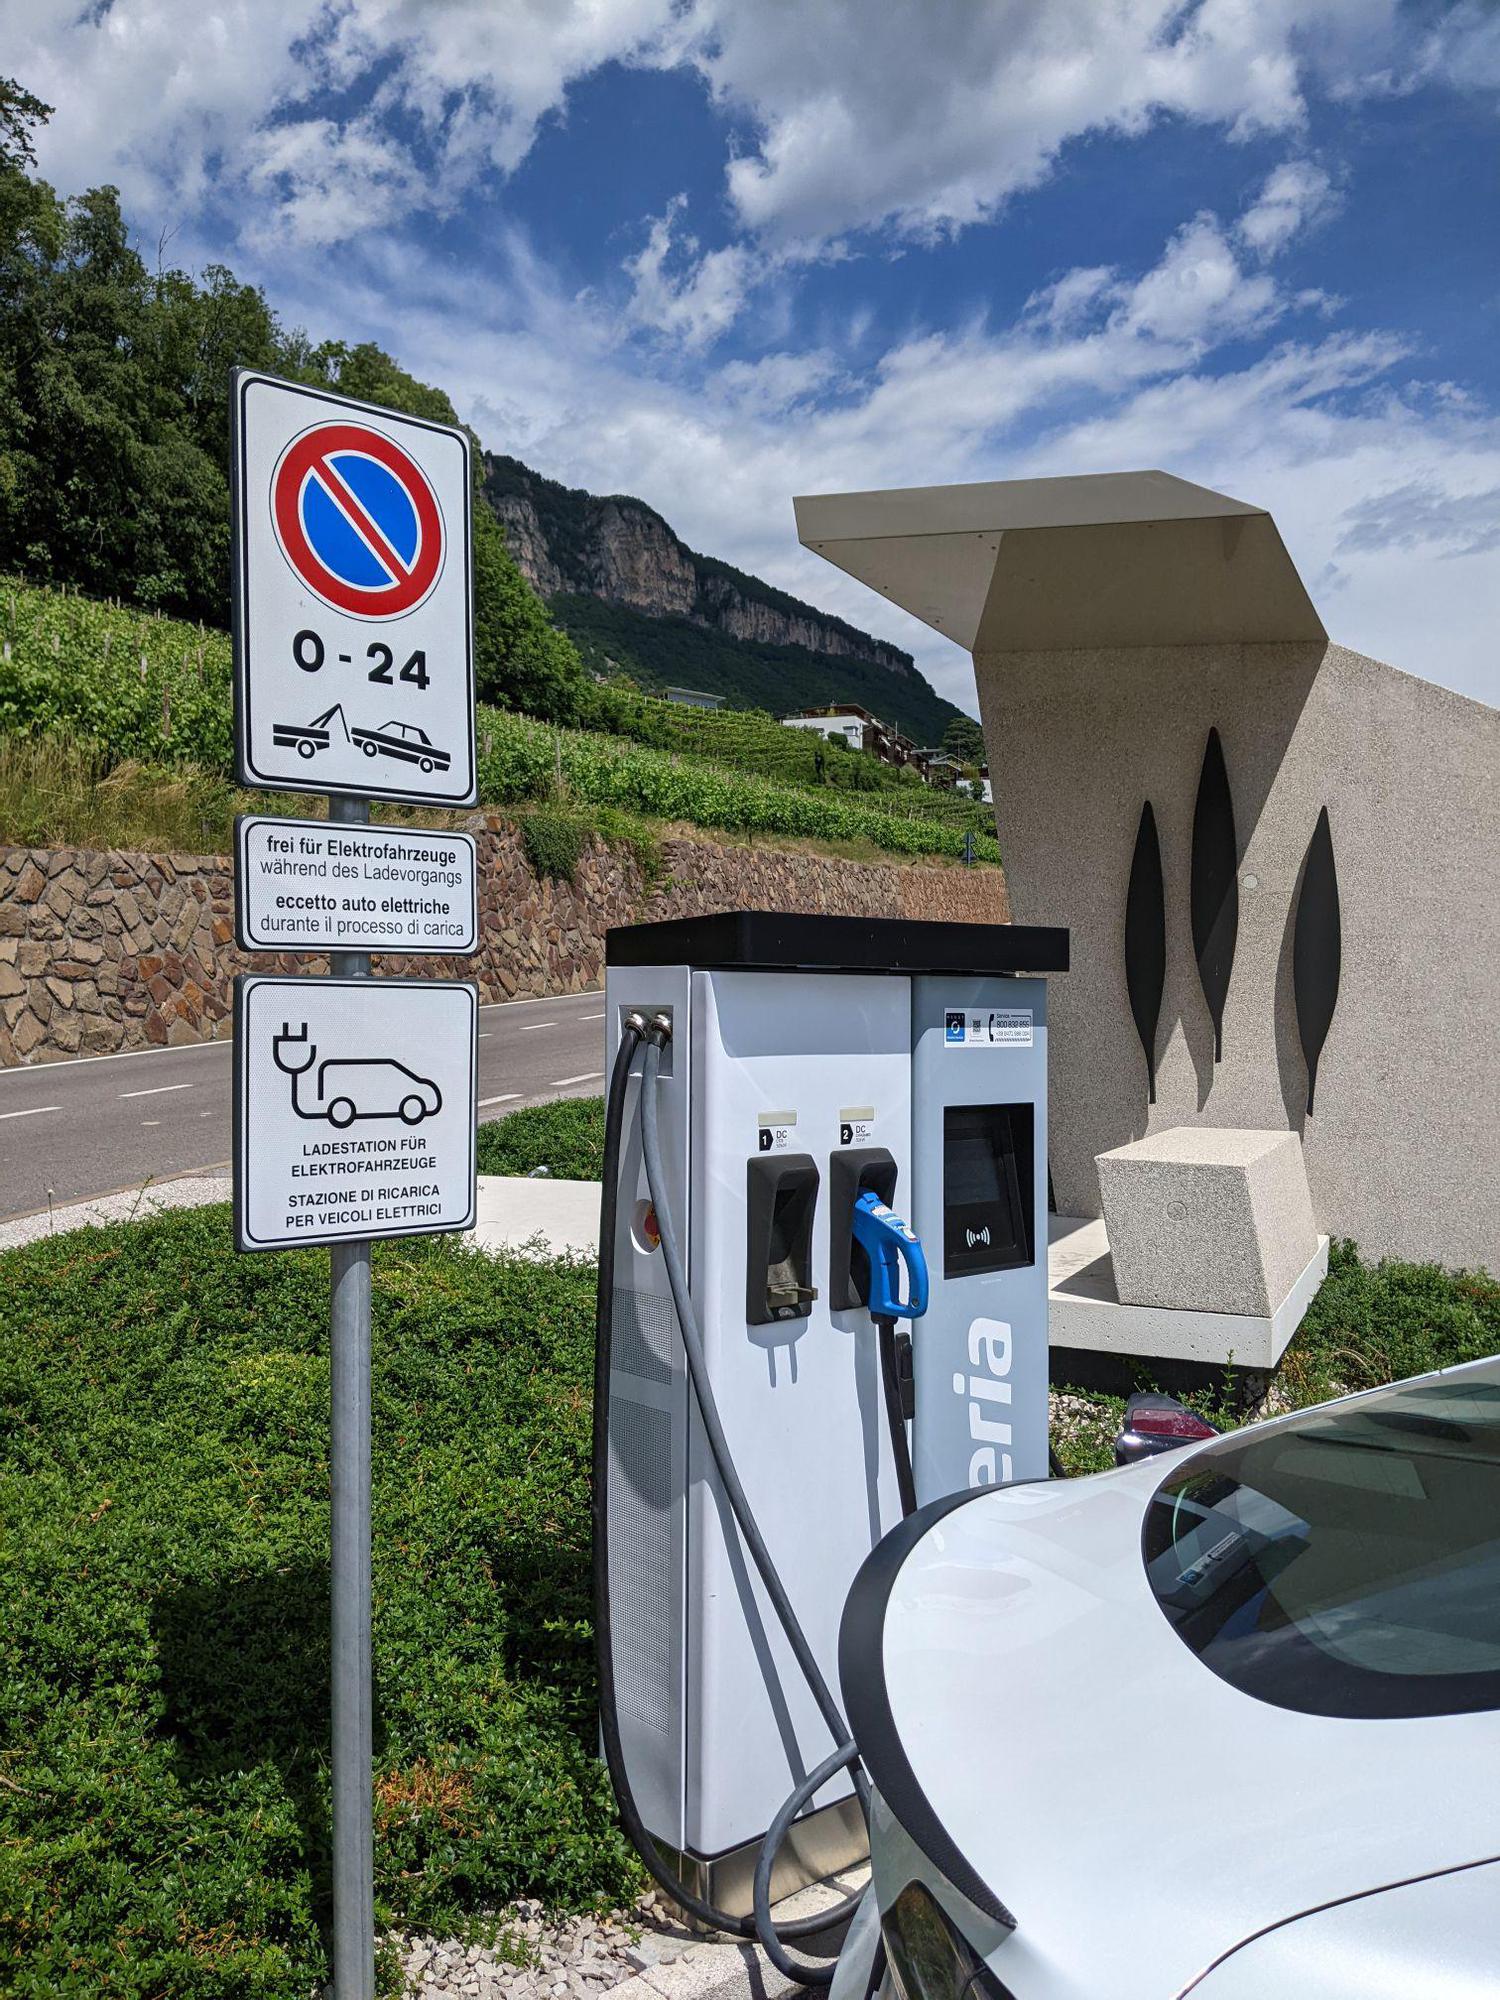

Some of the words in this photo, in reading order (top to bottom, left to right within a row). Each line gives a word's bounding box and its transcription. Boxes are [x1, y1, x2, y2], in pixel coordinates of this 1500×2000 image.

[292, 629, 325, 673] 0
[366, 642, 431, 690] 24
[267, 836, 294, 853] frei
[299, 837, 322, 856] für
[328, 840, 456, 866] Elektrofahrzeuge
[260, 858, 327, 877] während
[332, 862, 359, 880] des
[364, 863, 462, 888] Ladevorgangs
[276, 894, 336, 911] eccetto
[342, 896, 376, 912] auto
[381, 896, 450, 915] elettriche
[261, 914, 320, 933] durante
[325, 915, 332, 933] il
[337, 920, 403, 936] processo
[407, 916, 419, 934] di
[424, 918, 464, 936] carica
[762, 1135, 767, 1145] 1
[776, 1130, 788, 1139] DC
[843, 1129, 848, 1140] 2
[855, 1125, 866, 1134] DC
[303, 1140, 397, 1156] LADESTATION
[400, 1135, 427, 1150] FÜR
[291, 1157, 436, 1177] ELEKTROFAHRZEUGE
[288, 1190, 357, 1207] STAZIONE
[361, 1189, 374, 1201] DI
[378, 1184, 440, 1200] RICARICA
[286, 1216, 314, 1228] PER
[317, 1209, 372, 1225] VEICOLI
[376, 1203, 442, 1220] ELETTRICI
